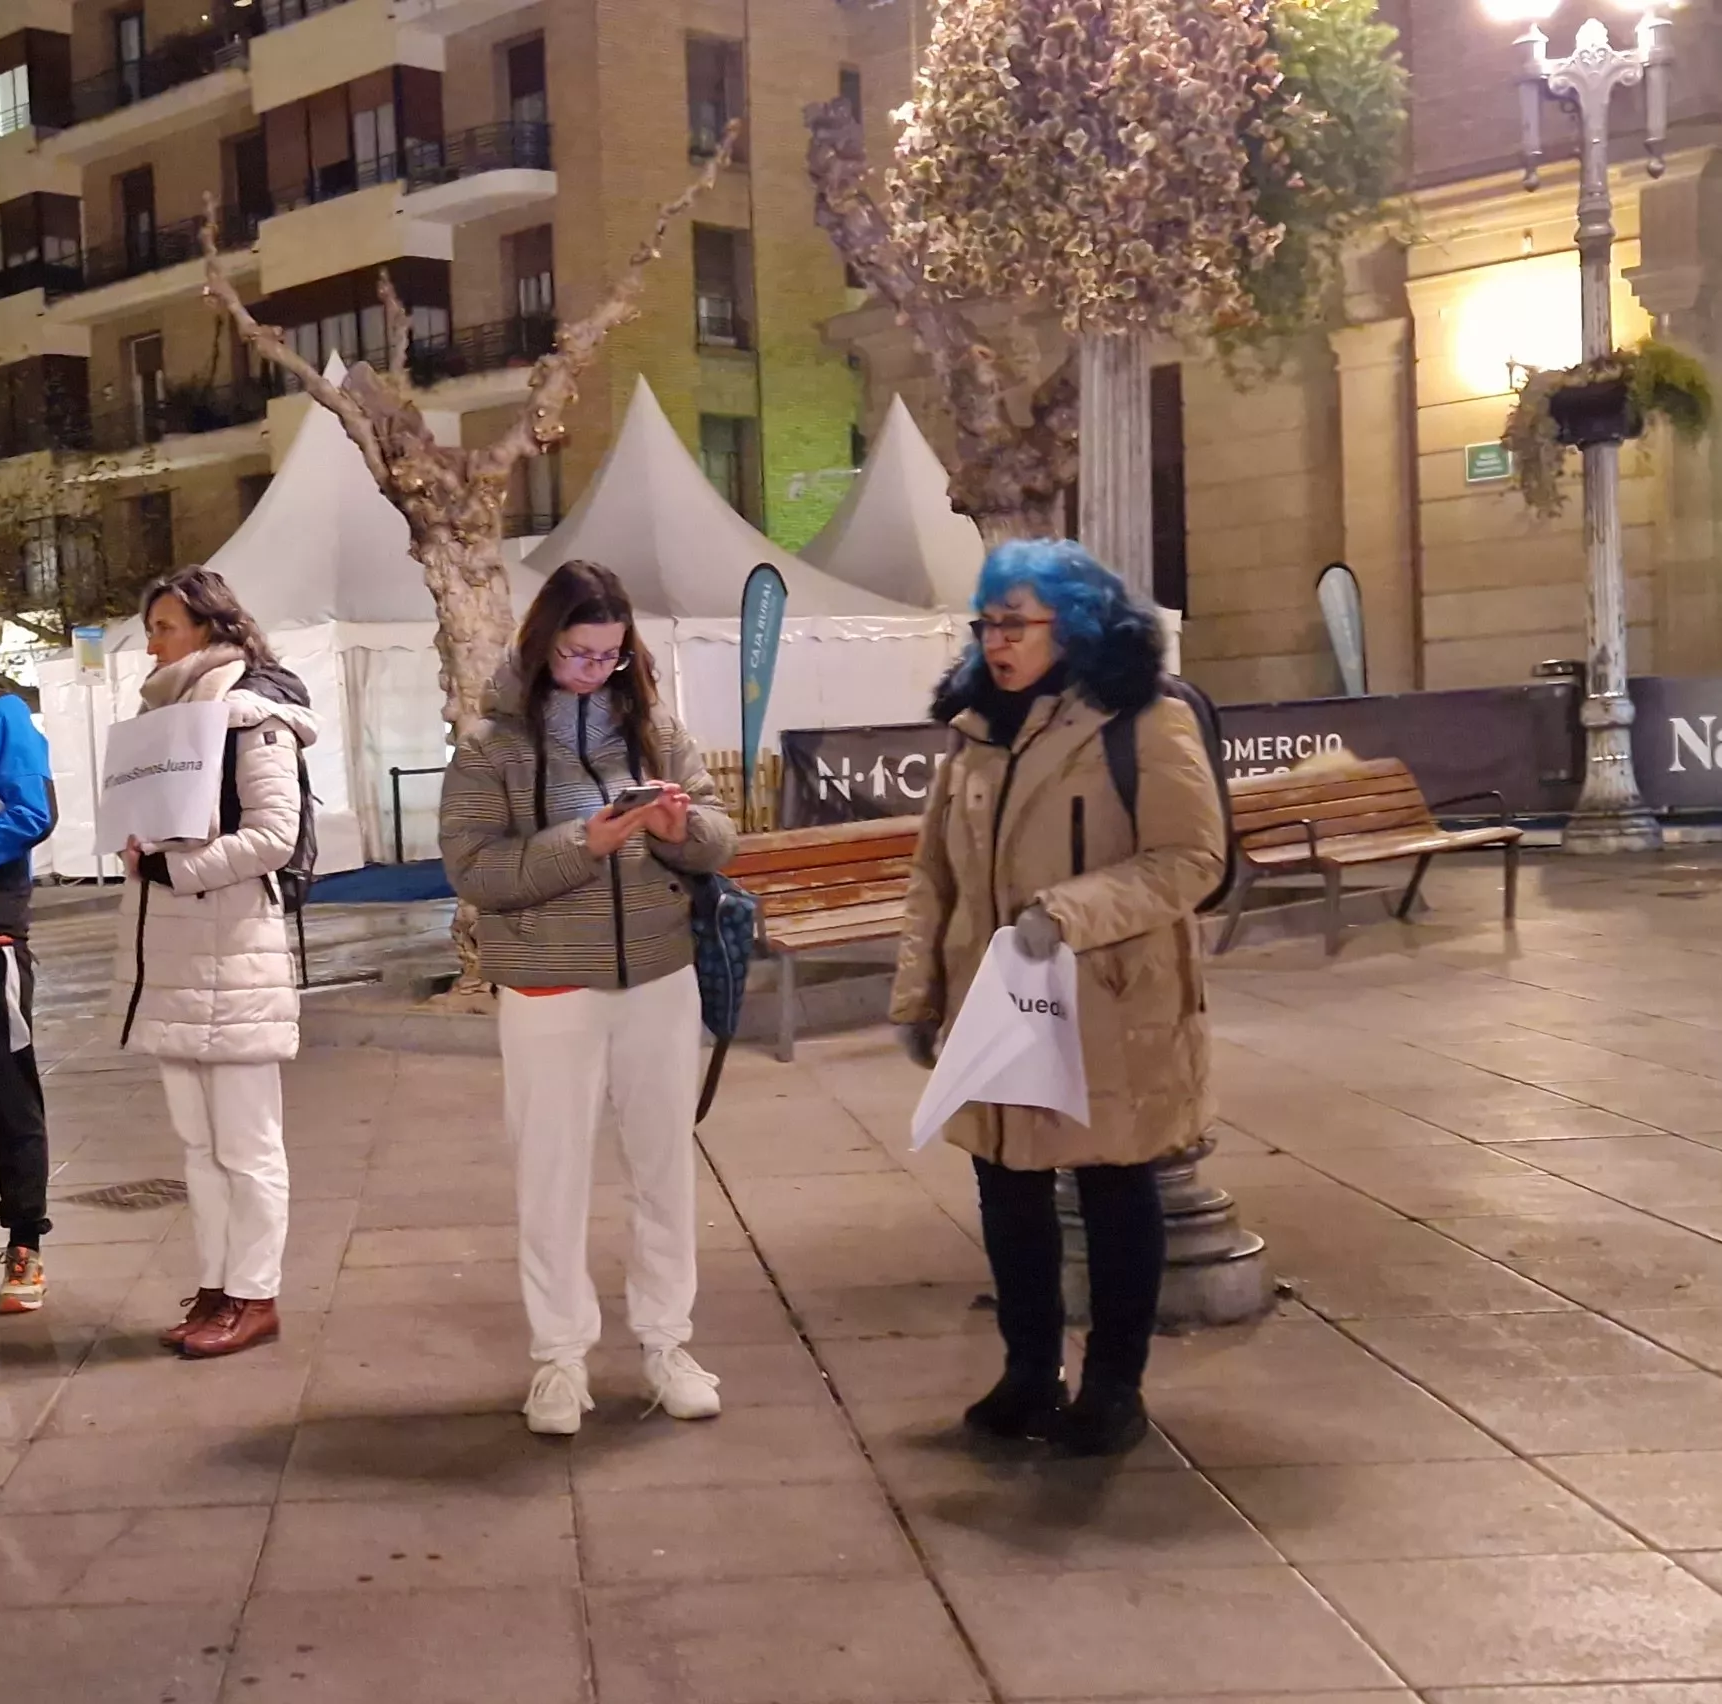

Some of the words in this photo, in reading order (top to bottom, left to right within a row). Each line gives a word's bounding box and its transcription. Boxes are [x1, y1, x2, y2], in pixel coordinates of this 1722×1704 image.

[750, 633, 764, 668] CAJA
[757, 583, 773, 630] RURAL
[1668, 715, 1722, 772] N
